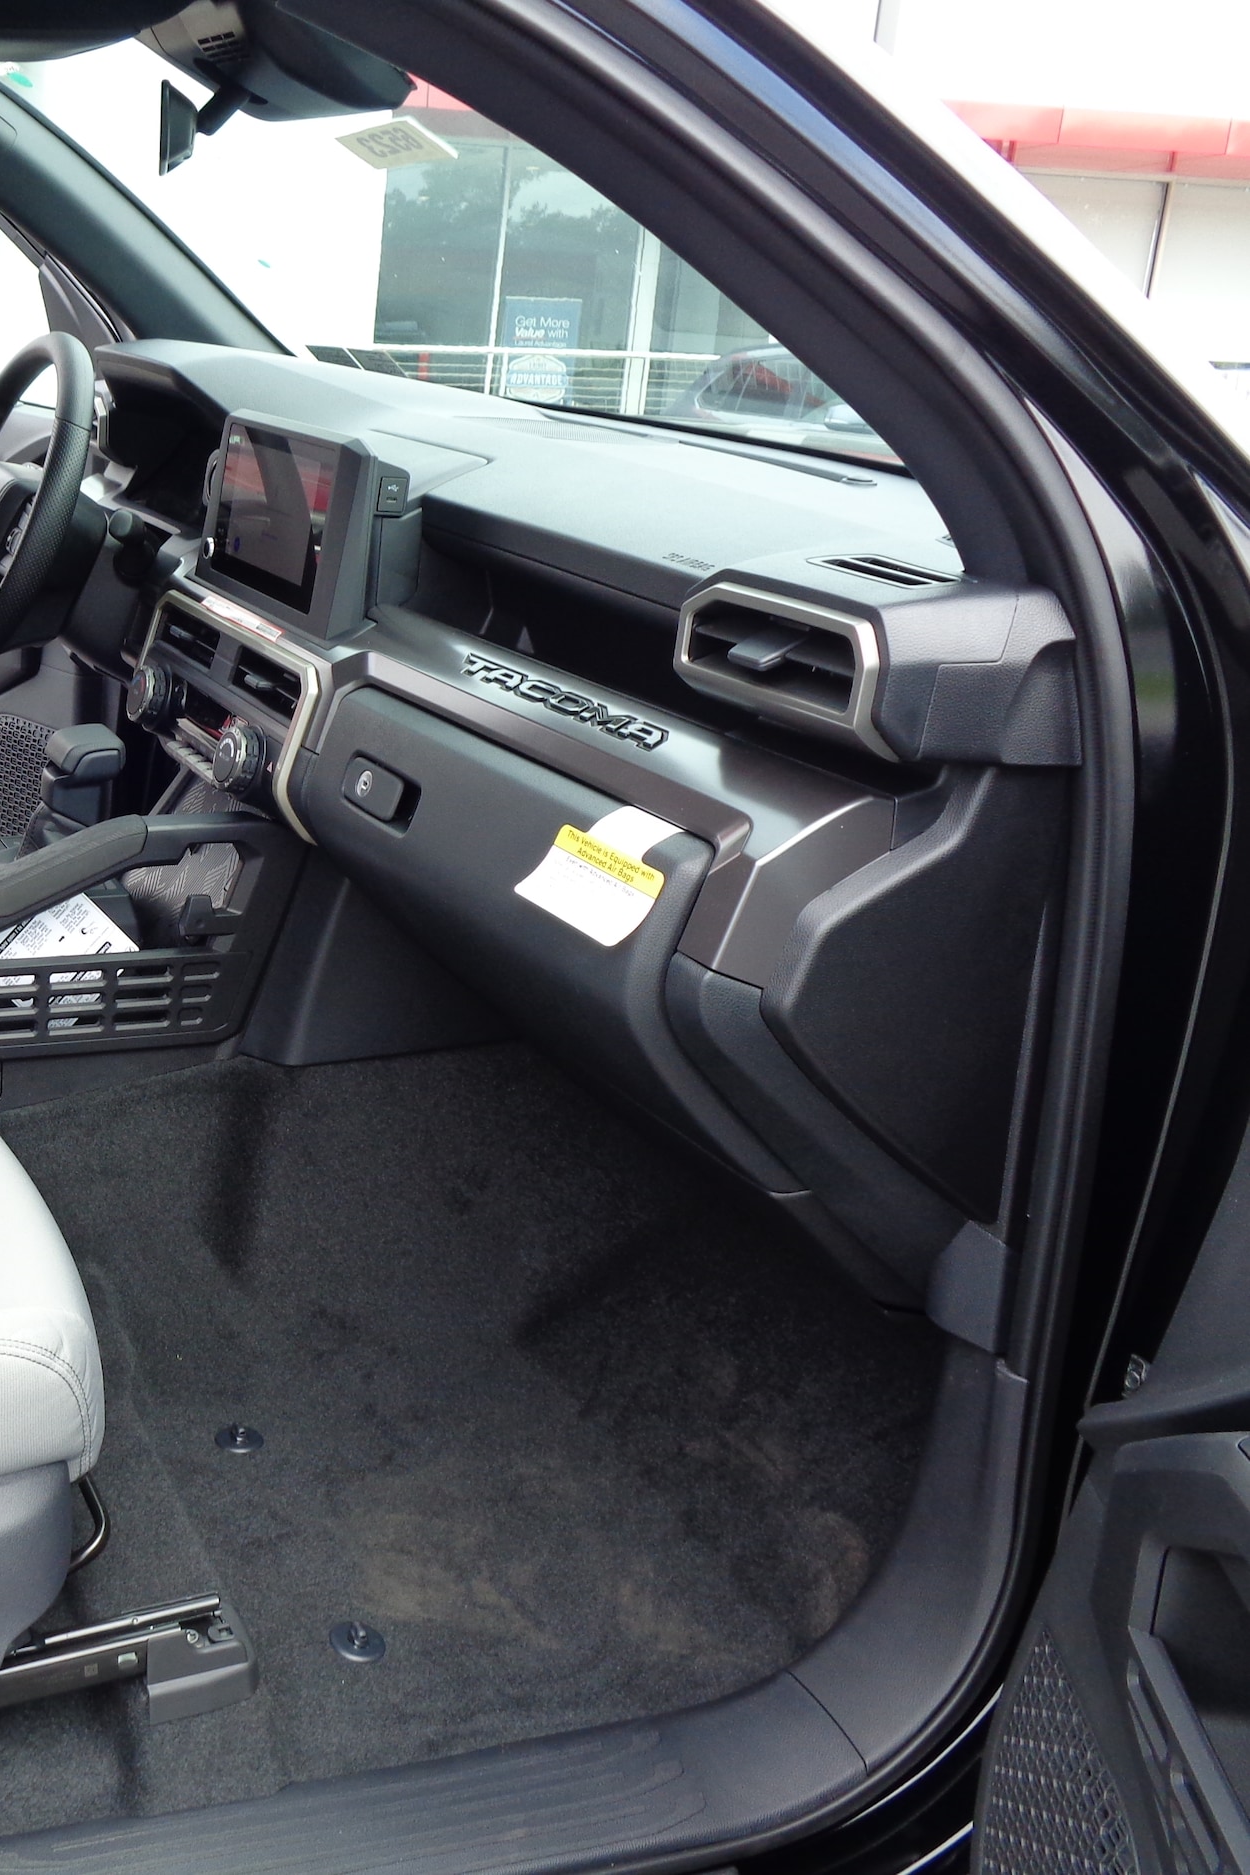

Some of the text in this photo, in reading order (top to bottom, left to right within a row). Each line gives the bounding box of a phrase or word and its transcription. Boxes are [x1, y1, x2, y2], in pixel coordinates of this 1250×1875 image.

[515, 315, 570, 329] Get More
[515, 327, 568, 339] Value with
[510, 373, 562, 386] ADVANTAGE
[461, 652, 670, 752] TACOMA
[567, 830, 580, 842] This
[581, 837, 603, 854] Vehicle
[609, 852, 640, 874] Equipped
[640, 869, 655, 882] with
[577, 847, 635, 884] Advanced Air Bags
